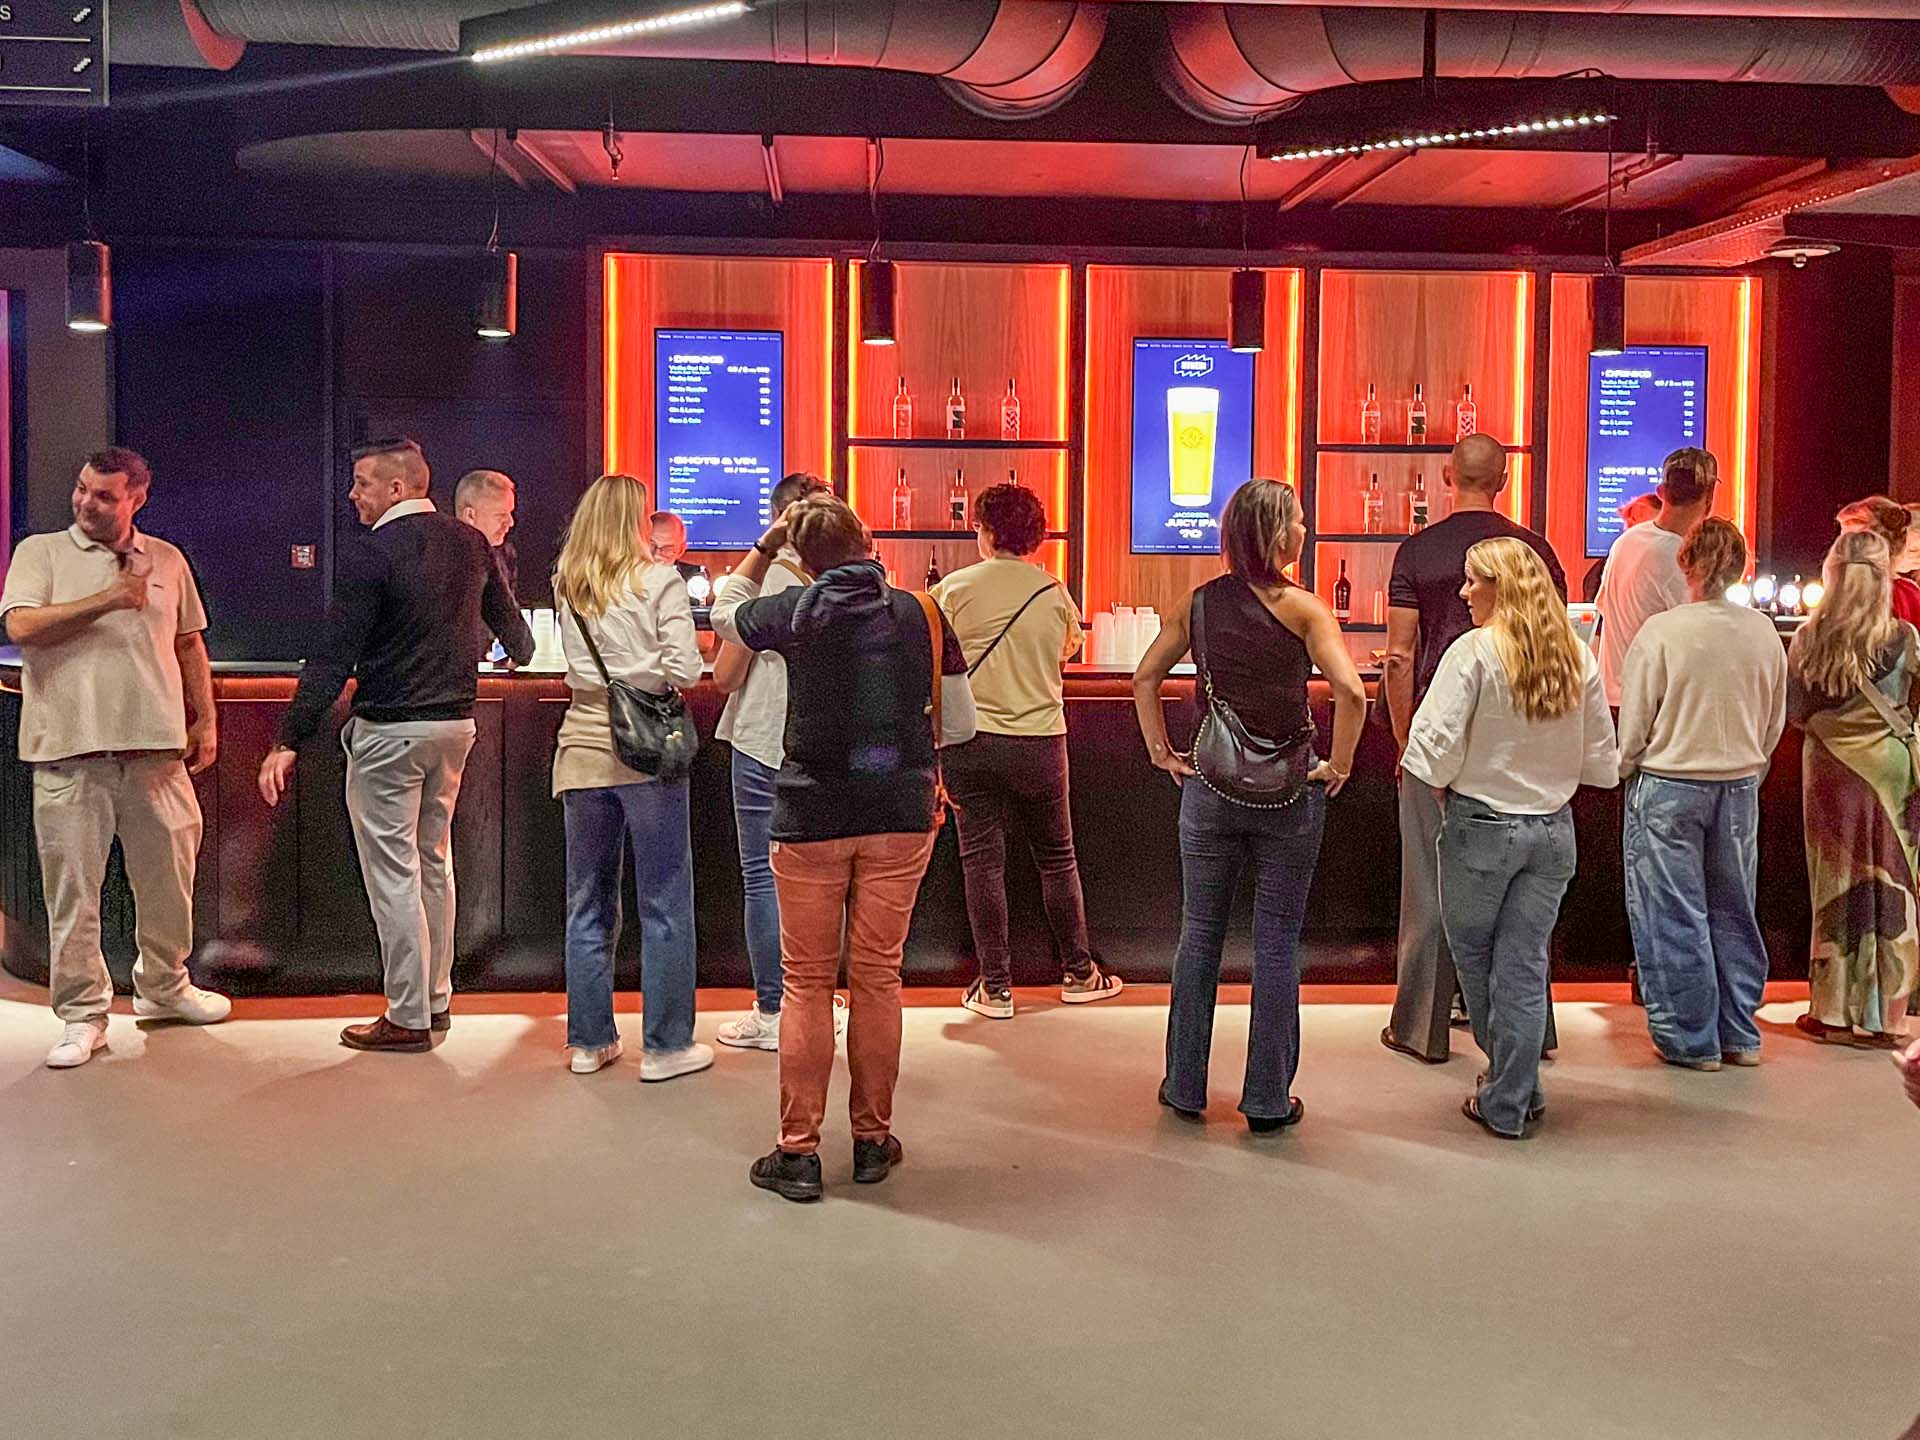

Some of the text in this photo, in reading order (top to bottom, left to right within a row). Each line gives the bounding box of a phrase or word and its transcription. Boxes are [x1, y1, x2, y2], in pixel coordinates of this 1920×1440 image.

[674, 456, 757, 465] SHOTS & VIN
[1603, 467, 1646, 475] SHOTS
[1165, 519, 1217, 527] JUICY IPA
[1179, 529, 1203, 538] 70
